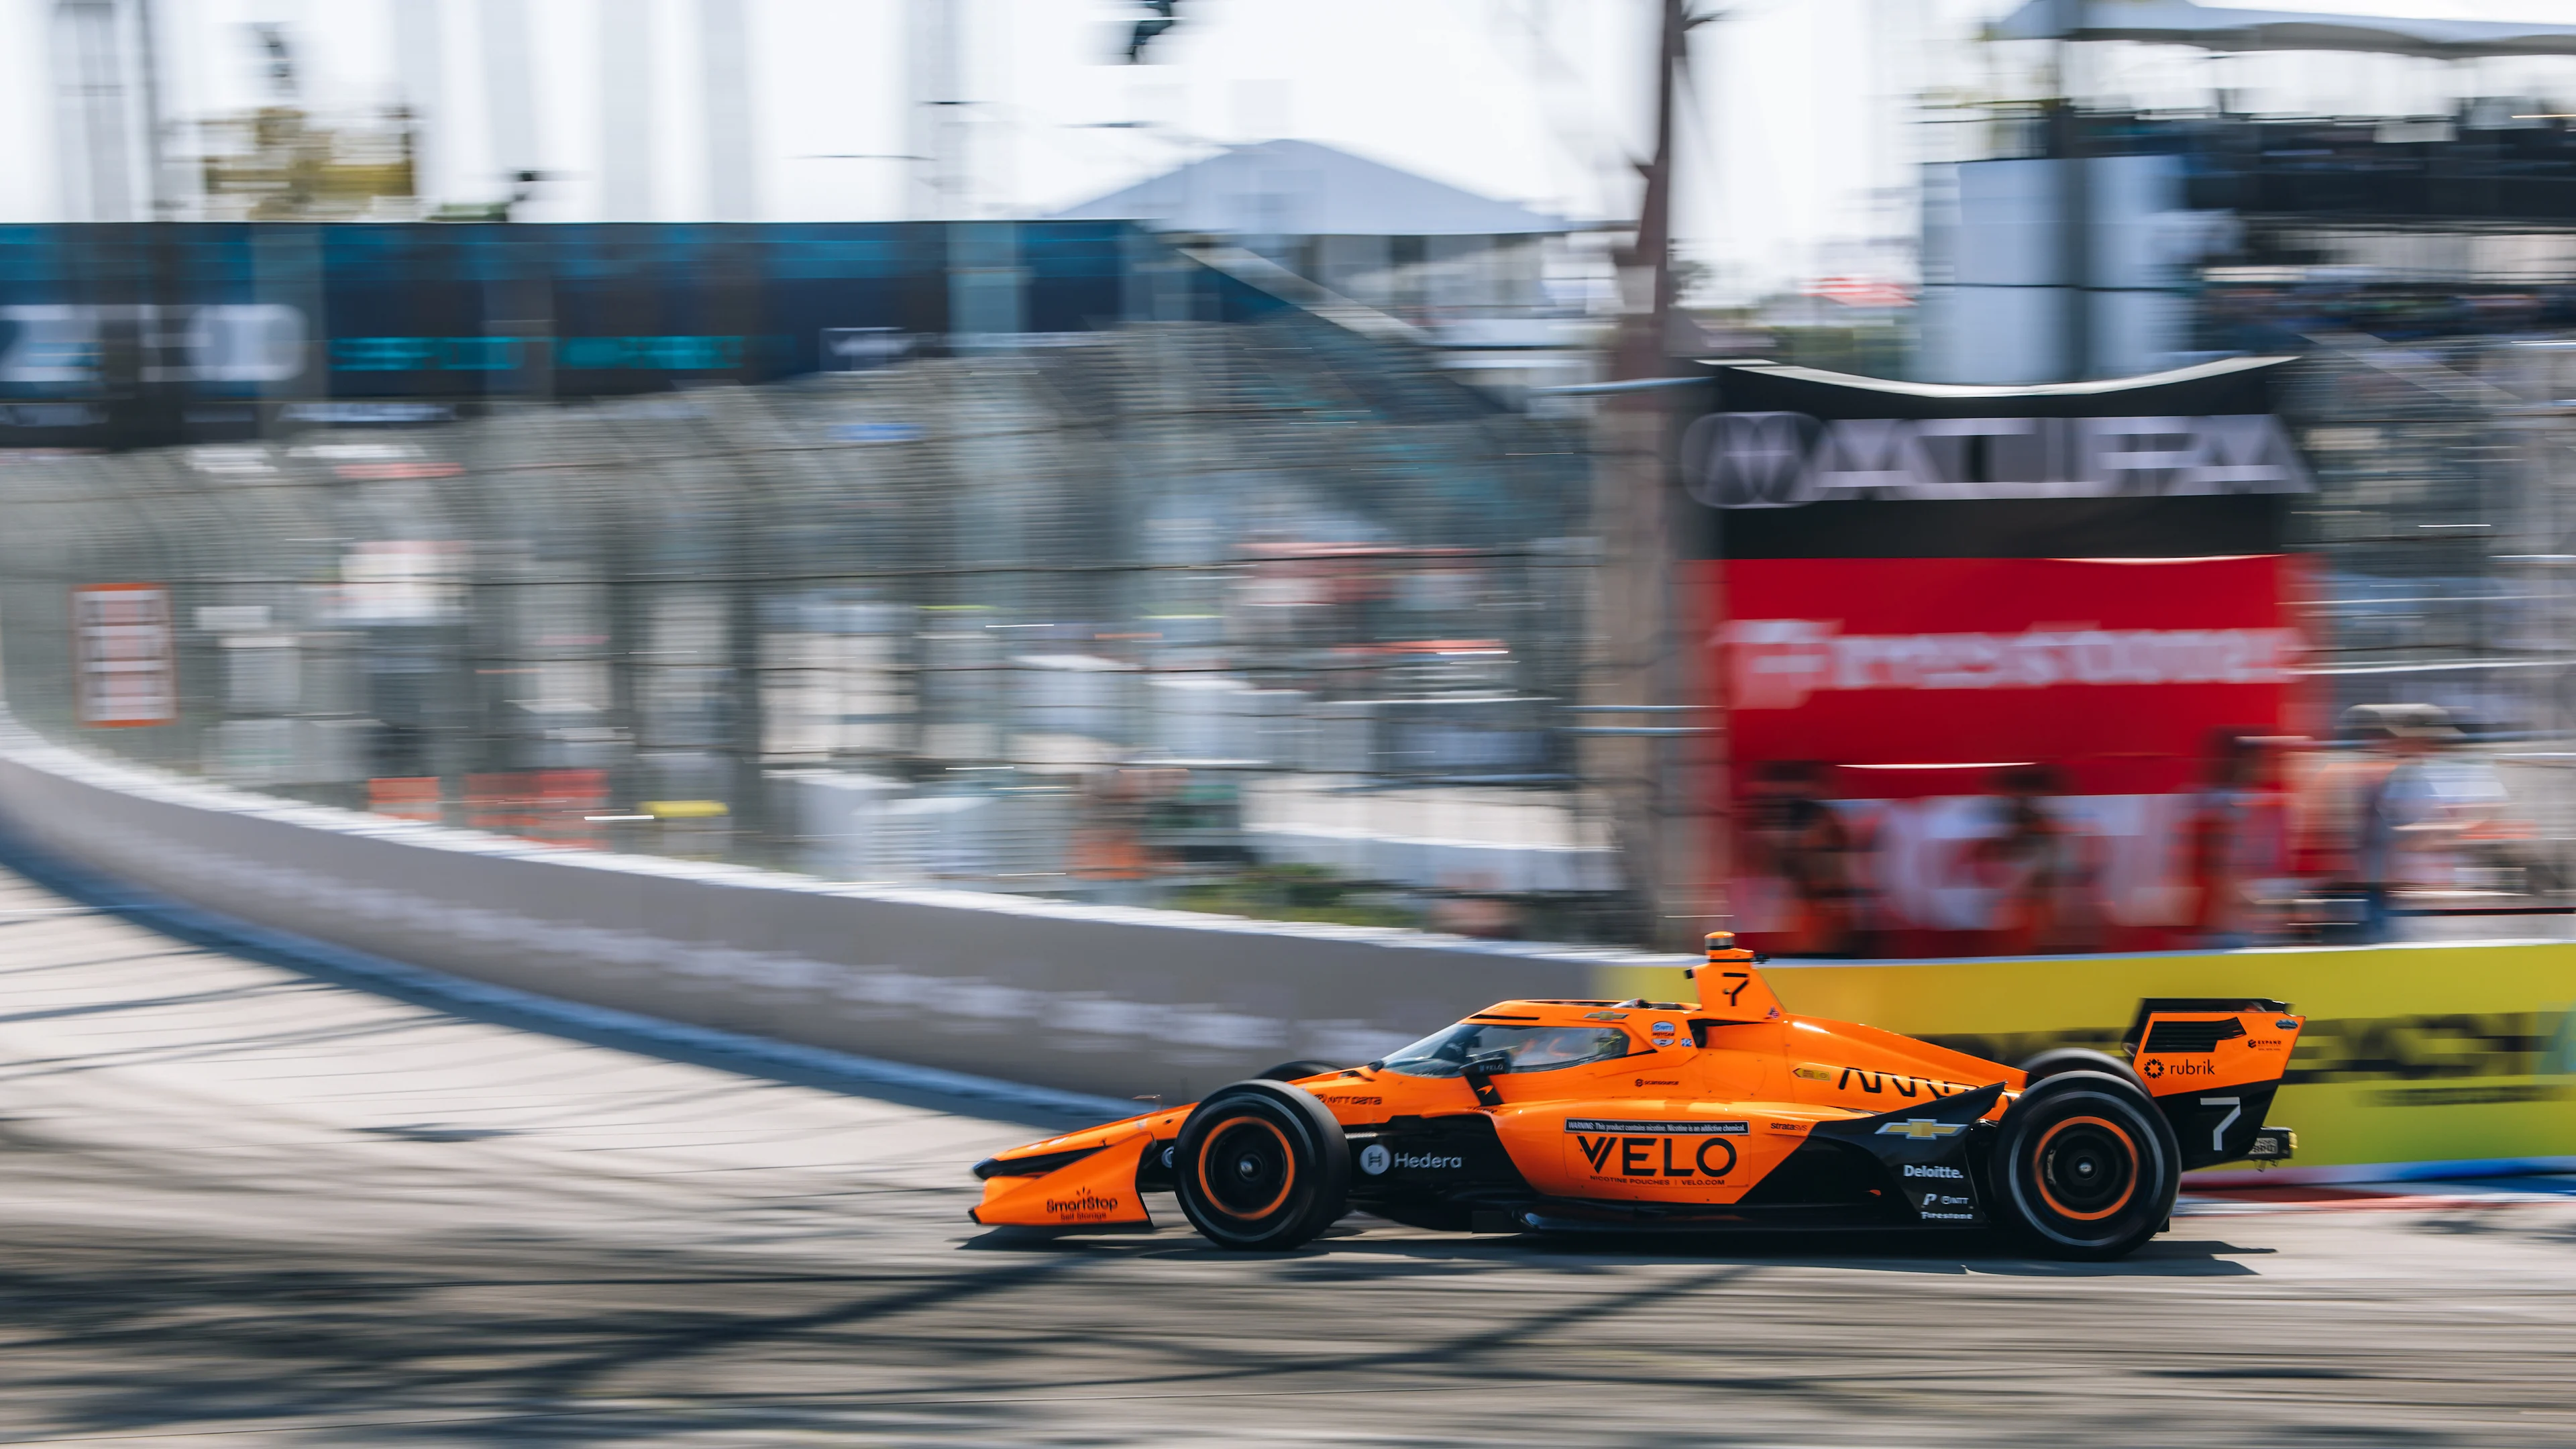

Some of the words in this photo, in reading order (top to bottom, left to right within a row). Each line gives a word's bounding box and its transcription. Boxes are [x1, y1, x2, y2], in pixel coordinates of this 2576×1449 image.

[1721, 972, 1750, 1007] 7
[2170, 1059, 2215, 1075] rubrik
[2200, 1096, 2241, 1151] 7
[1394, 1152, 1462, 1168] Hedera
[1576, 1135, 1737, 1177] VELO
[1590, 1175, 1627, 1183] NICOTINE
[1903, 1164, 1964, 1179] Deloitte.
[1046, 1196, 1118, 1214] SmartStop
